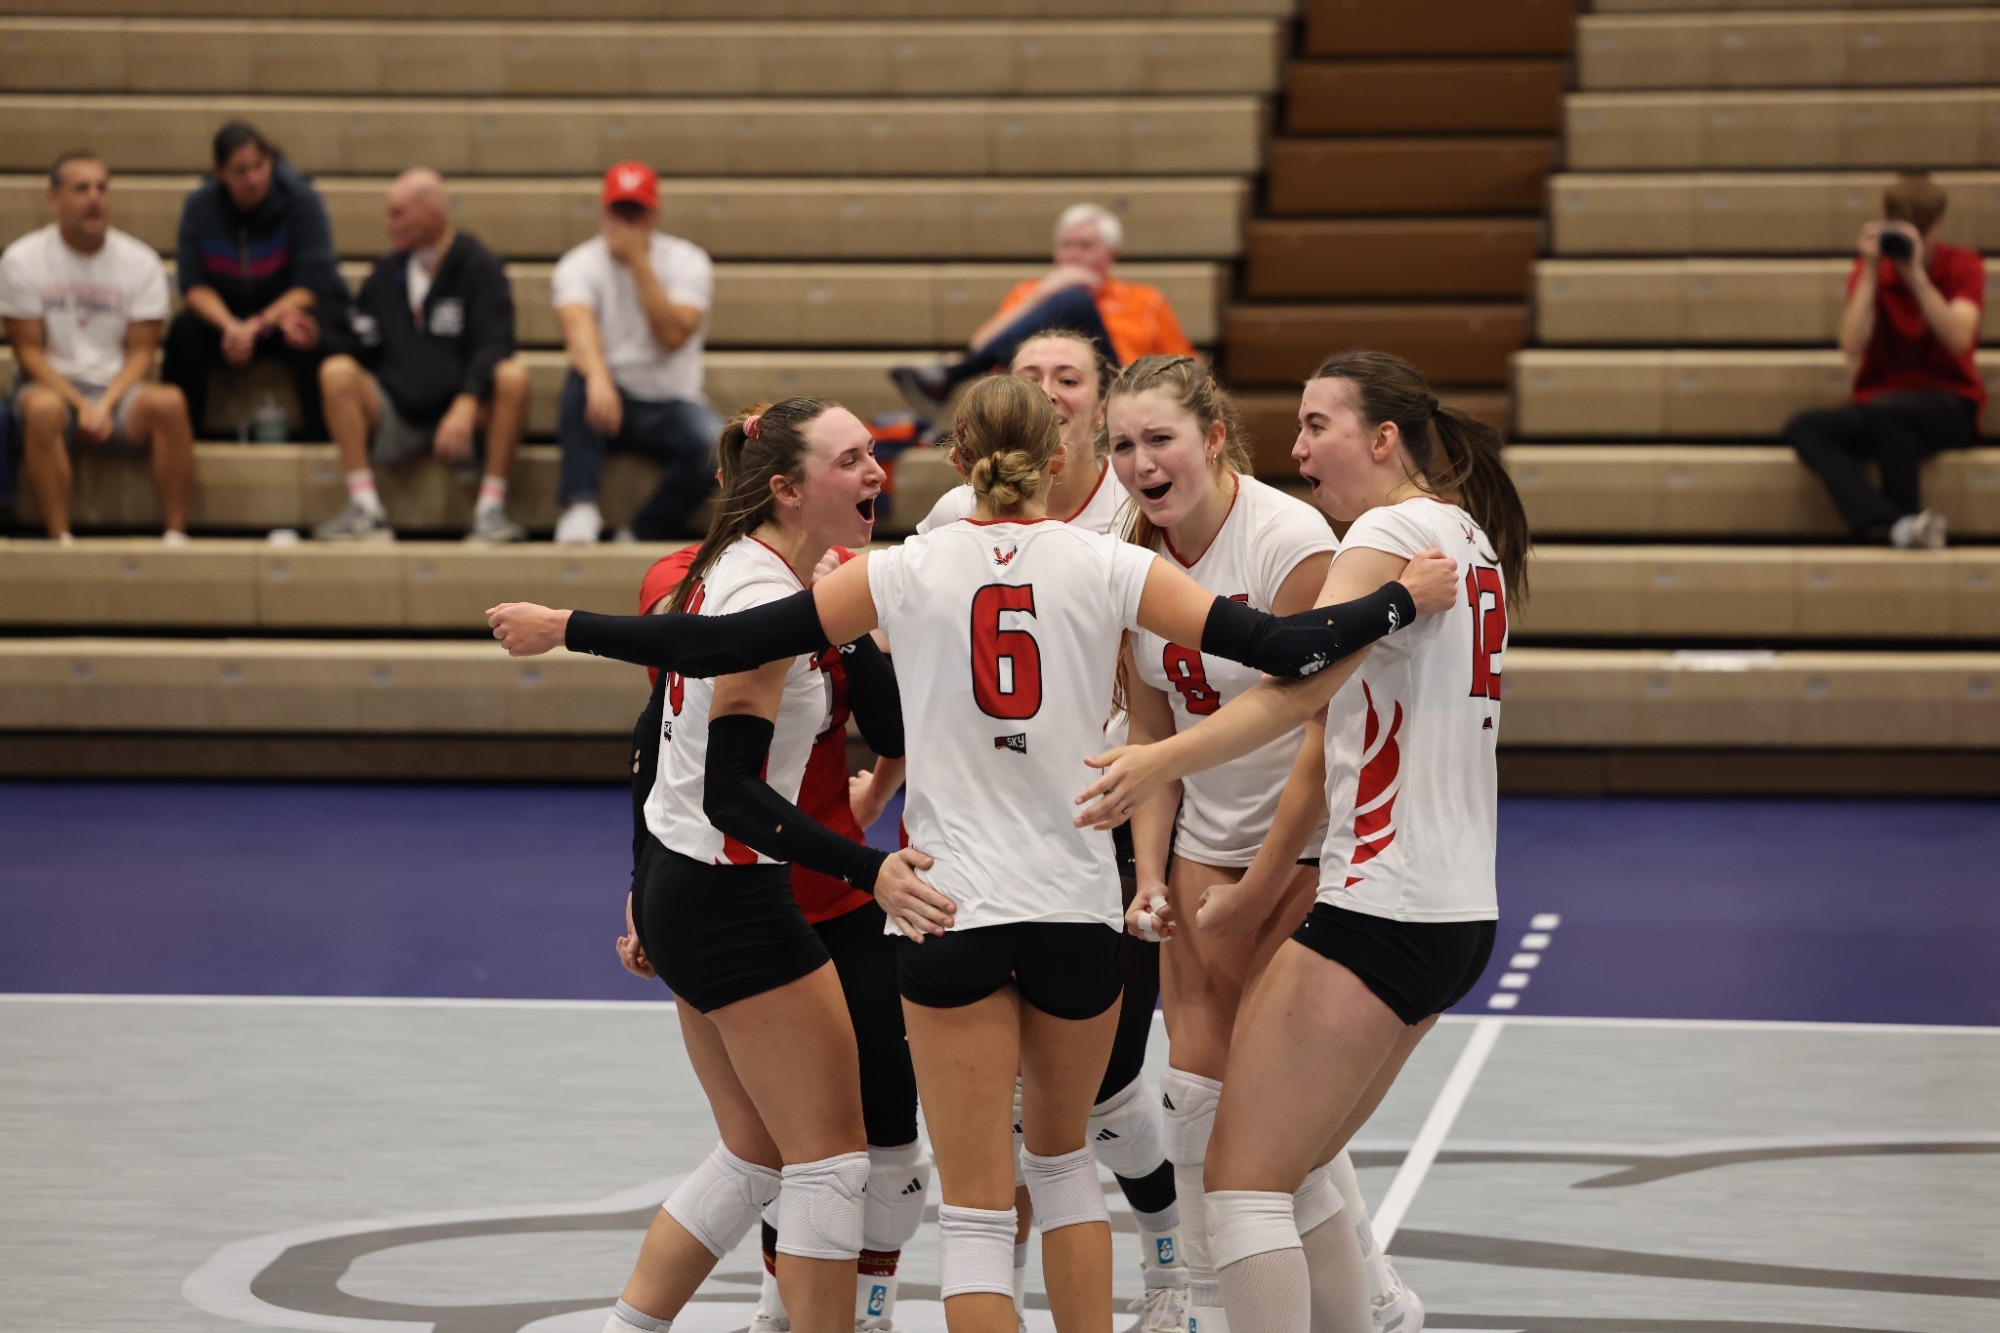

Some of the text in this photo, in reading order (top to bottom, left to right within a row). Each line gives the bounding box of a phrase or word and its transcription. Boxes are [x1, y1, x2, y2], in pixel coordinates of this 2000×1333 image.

[970, 583, 1043, 720] 6
[1162, 642, 1221, 716] 8
[1465, 563, 1507, 701] 12
[1007, 734, 1025, 748] SKY
